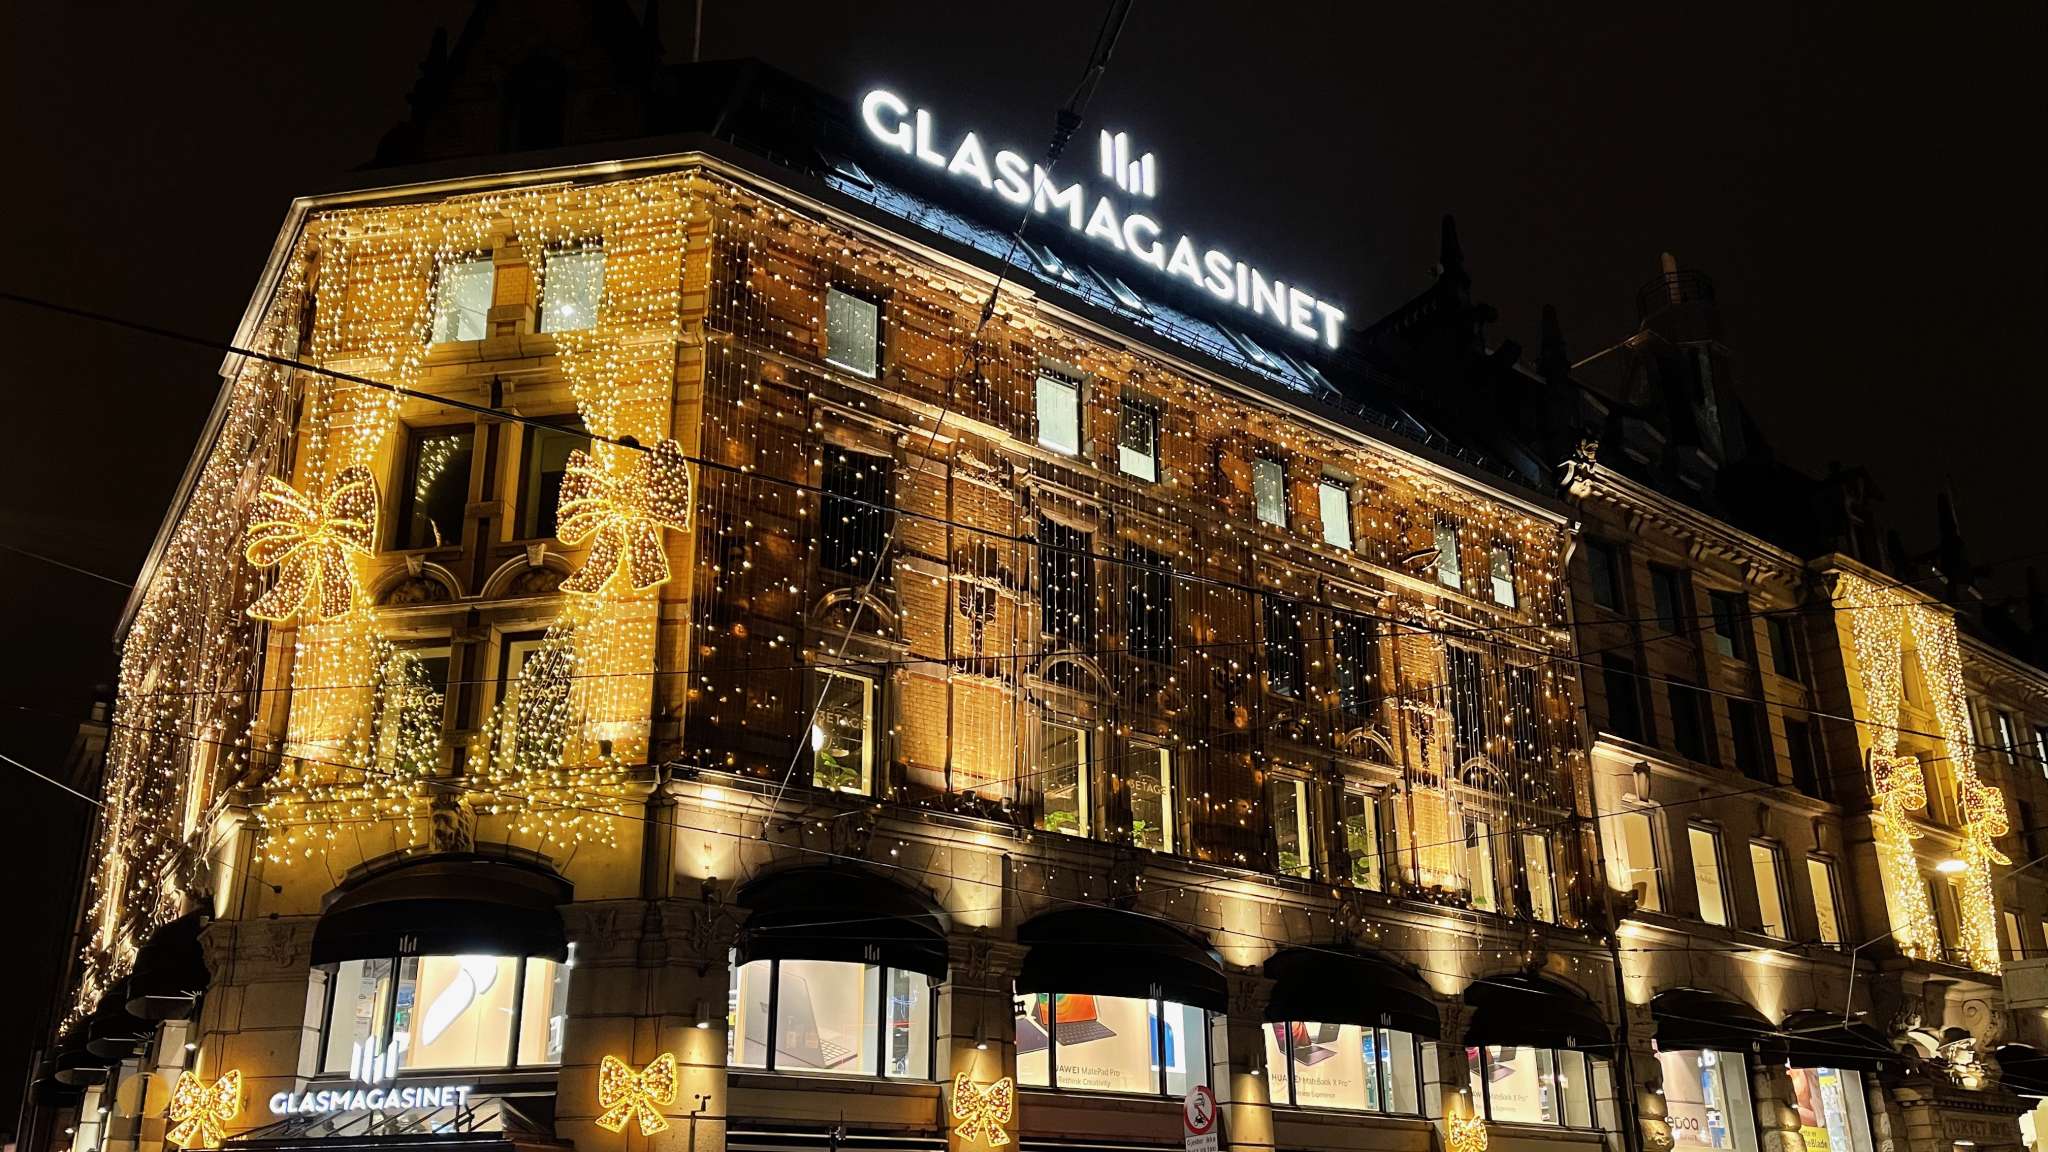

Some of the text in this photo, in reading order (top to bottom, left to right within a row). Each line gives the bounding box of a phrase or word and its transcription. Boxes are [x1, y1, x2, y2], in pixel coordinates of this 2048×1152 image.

[861, 89, 1345, 349] GLASMAGASINET
[1271, 1073, 1300, 1083] HUAEI
[269, 1086, 471, 1114] GLASMAGASINET
